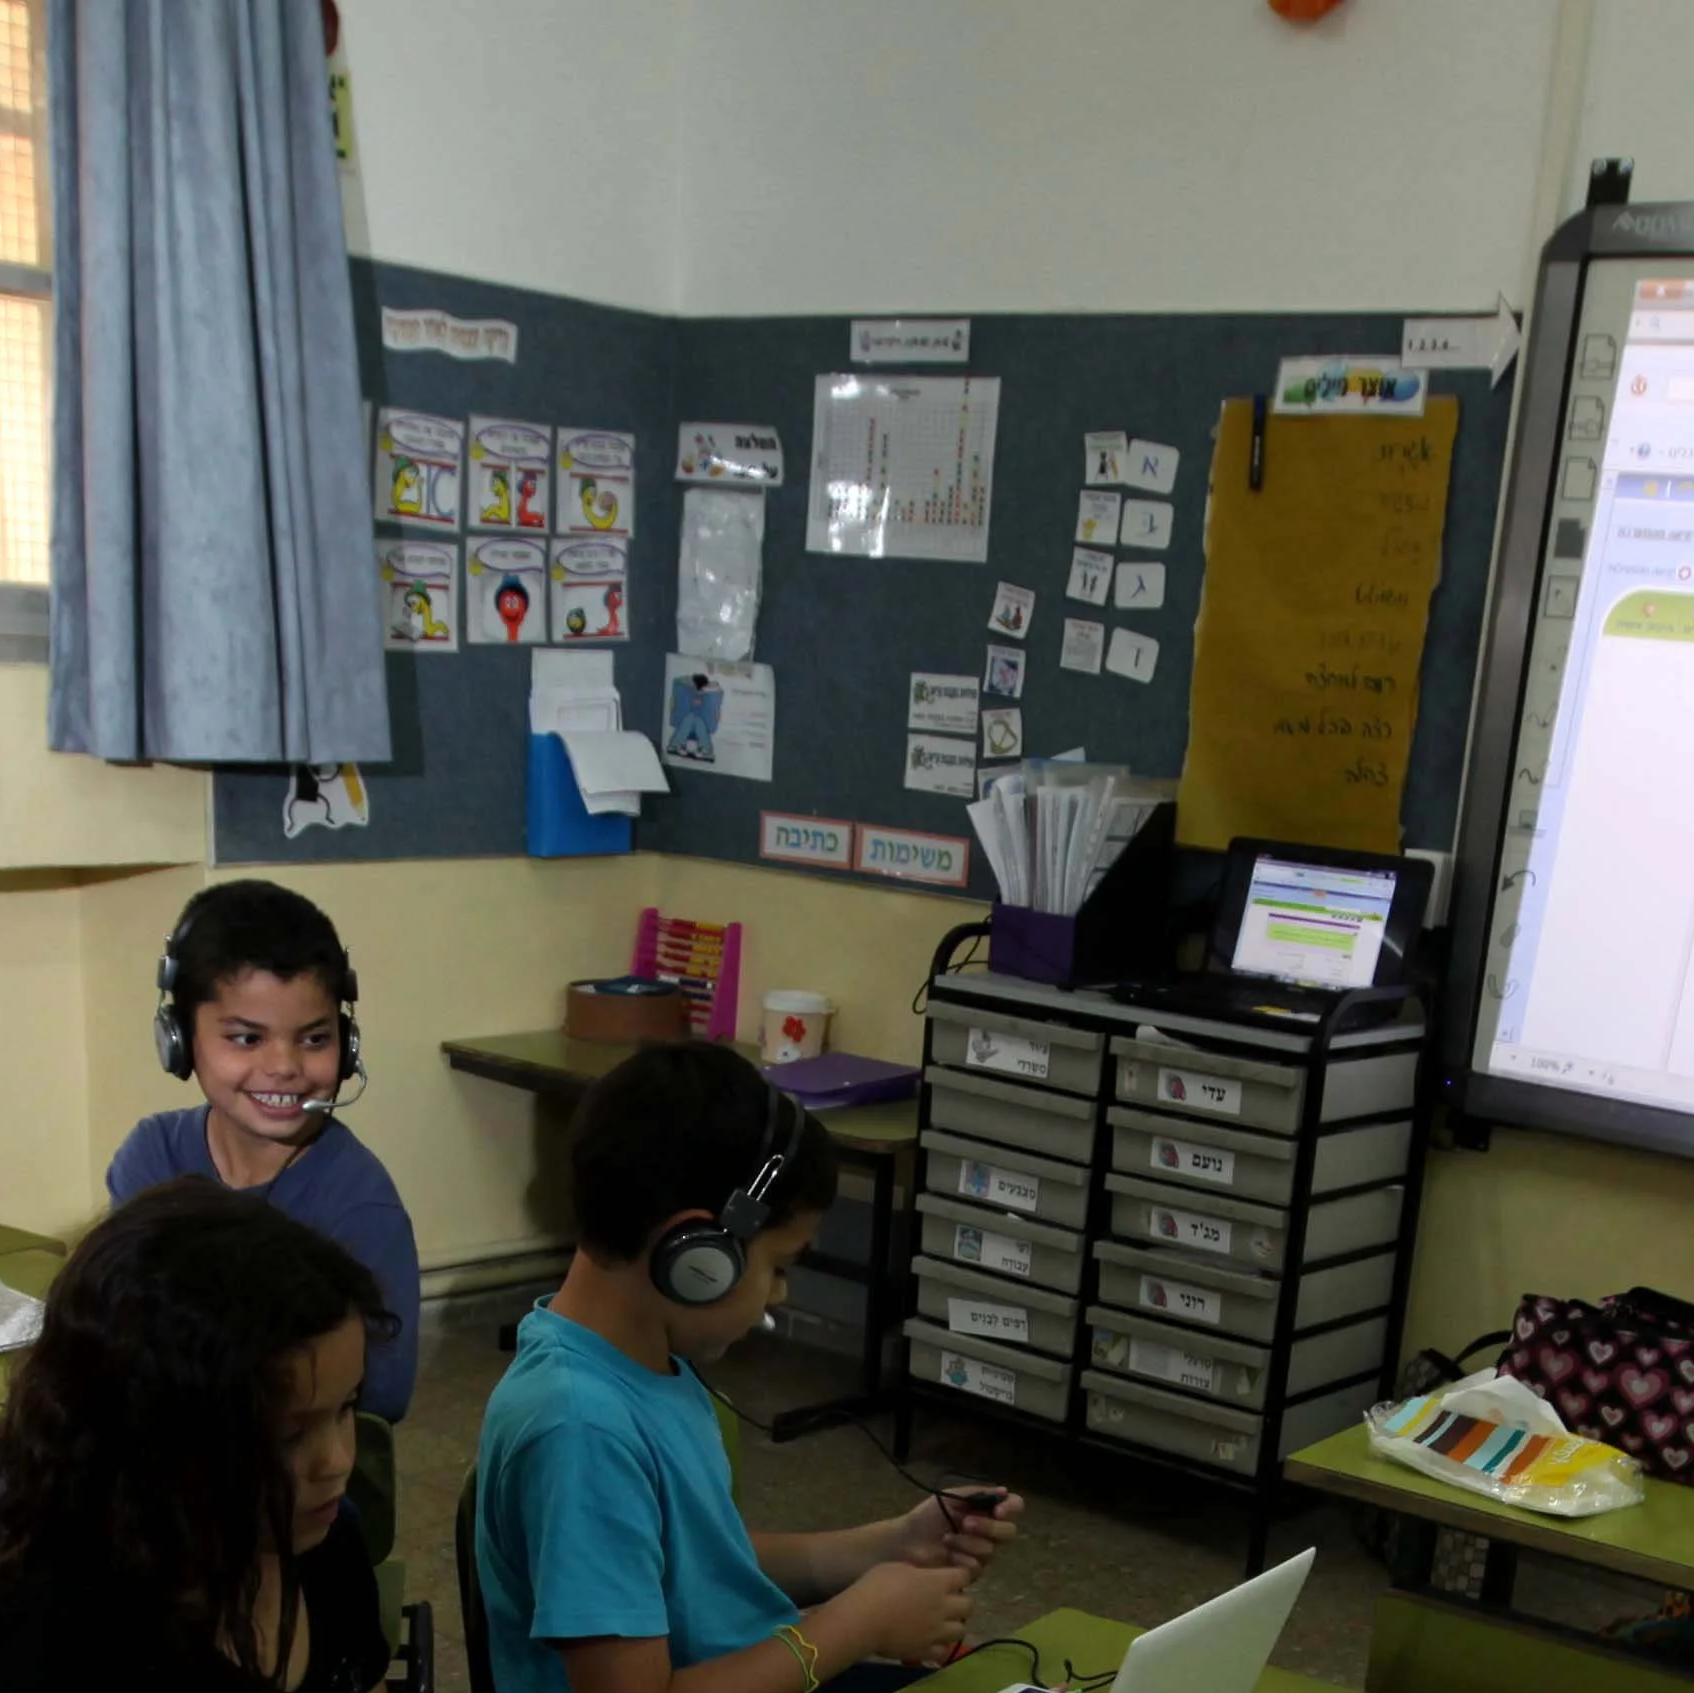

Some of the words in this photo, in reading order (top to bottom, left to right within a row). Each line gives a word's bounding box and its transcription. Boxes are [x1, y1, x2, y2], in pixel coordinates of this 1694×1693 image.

[1303, 374, 1348, 406] מילים
[1358, 377, 1397, 405] אוצר
[1141, 454, 1160, 479] א
[775, 825, 840, 852] כתיבה
[869, 836, 953, 872] משימות
[1202, 1083, 1227, 1103] עדי
[1191, 1153, 1224, 1174] נועם
[1179, 1291, 1206, 1312] רוני
